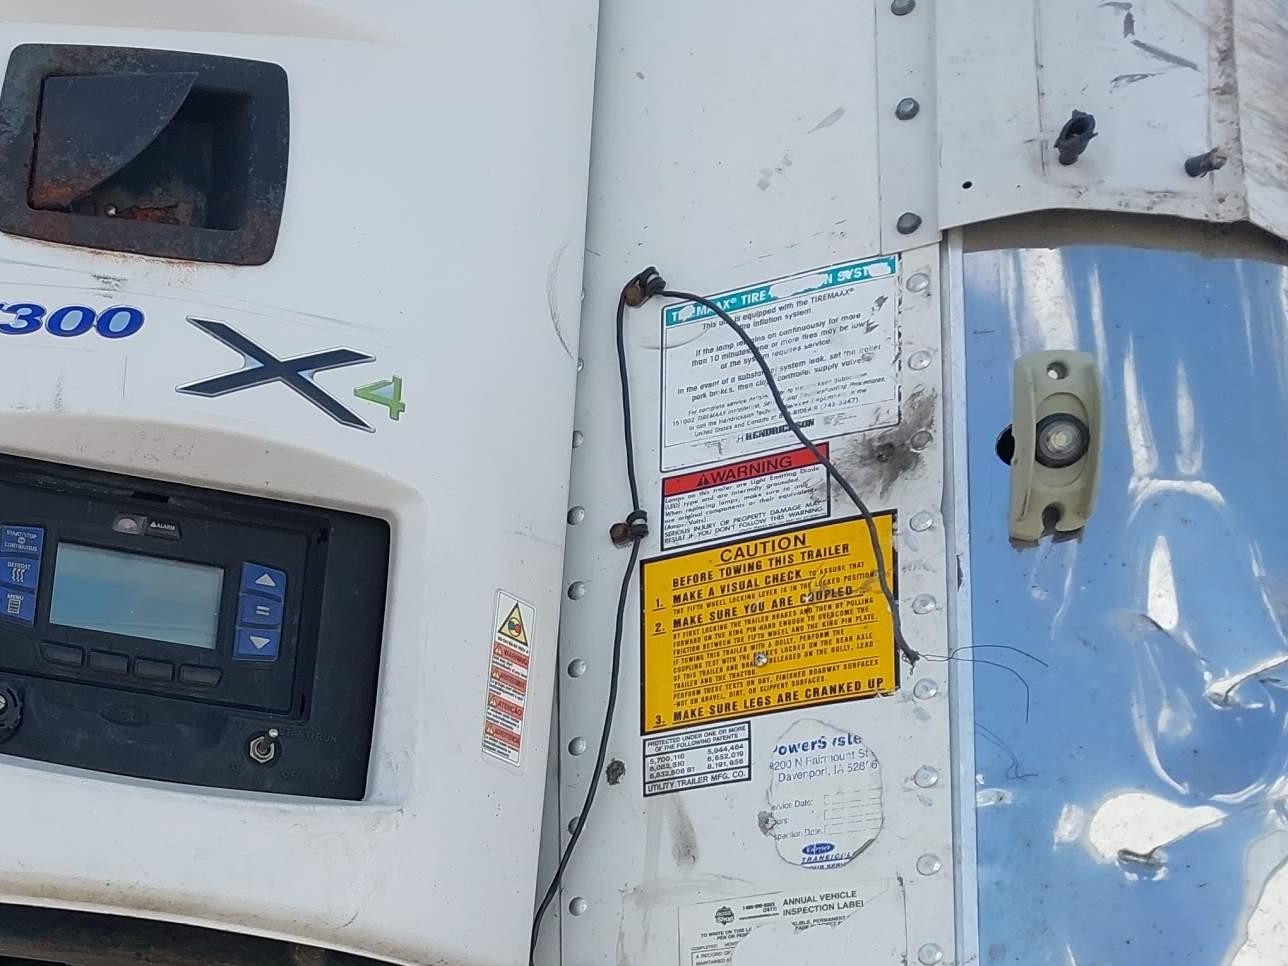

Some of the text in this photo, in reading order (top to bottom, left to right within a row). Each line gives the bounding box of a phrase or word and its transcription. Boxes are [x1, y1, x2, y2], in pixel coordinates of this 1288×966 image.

[741, 289, 766, 304] TIRE
[742, 307, 775, 321] equipped
[709, 354, 719, 362] 10
[711, 455, 792, 484] WARNING
[156, 522, 175, 530] ALARM
[693, 521, 716, 531] INJURY
[733, 510, 765, 523] PROPERTY
[770, 503, 800, 515] DAMAGE
[697, 513, 784, 537] YOU FOLLOW THIS
[720, 532, 805, 563] CAUTION
[672, 541, 848, 587] BEFORE TOWING THIS TRAILER
[655, 560, 864, 608] 1. MAKE A VISUAL CHECK THAT
[729, 587, 777, 604] LOCKING LEVER
[655, 583, 852, 633] 2. MAKE SURE YOU ARE COUPLED
[655, 676, 883, 725] 3. MAKE SURE LEGS ARE CRANKED UP
[676, 737, 710, 748] FOLLOWING
[682, 733, 701, 741] UNDER
[729, 725, 745, 733] MORE
[647, 769, 745, 792] UTILITY TRAILER MFG. CO.
[783, 890, 856, 906] ANNUAL VEHICLE
[783, 903, 833, 916] INSPECTION
